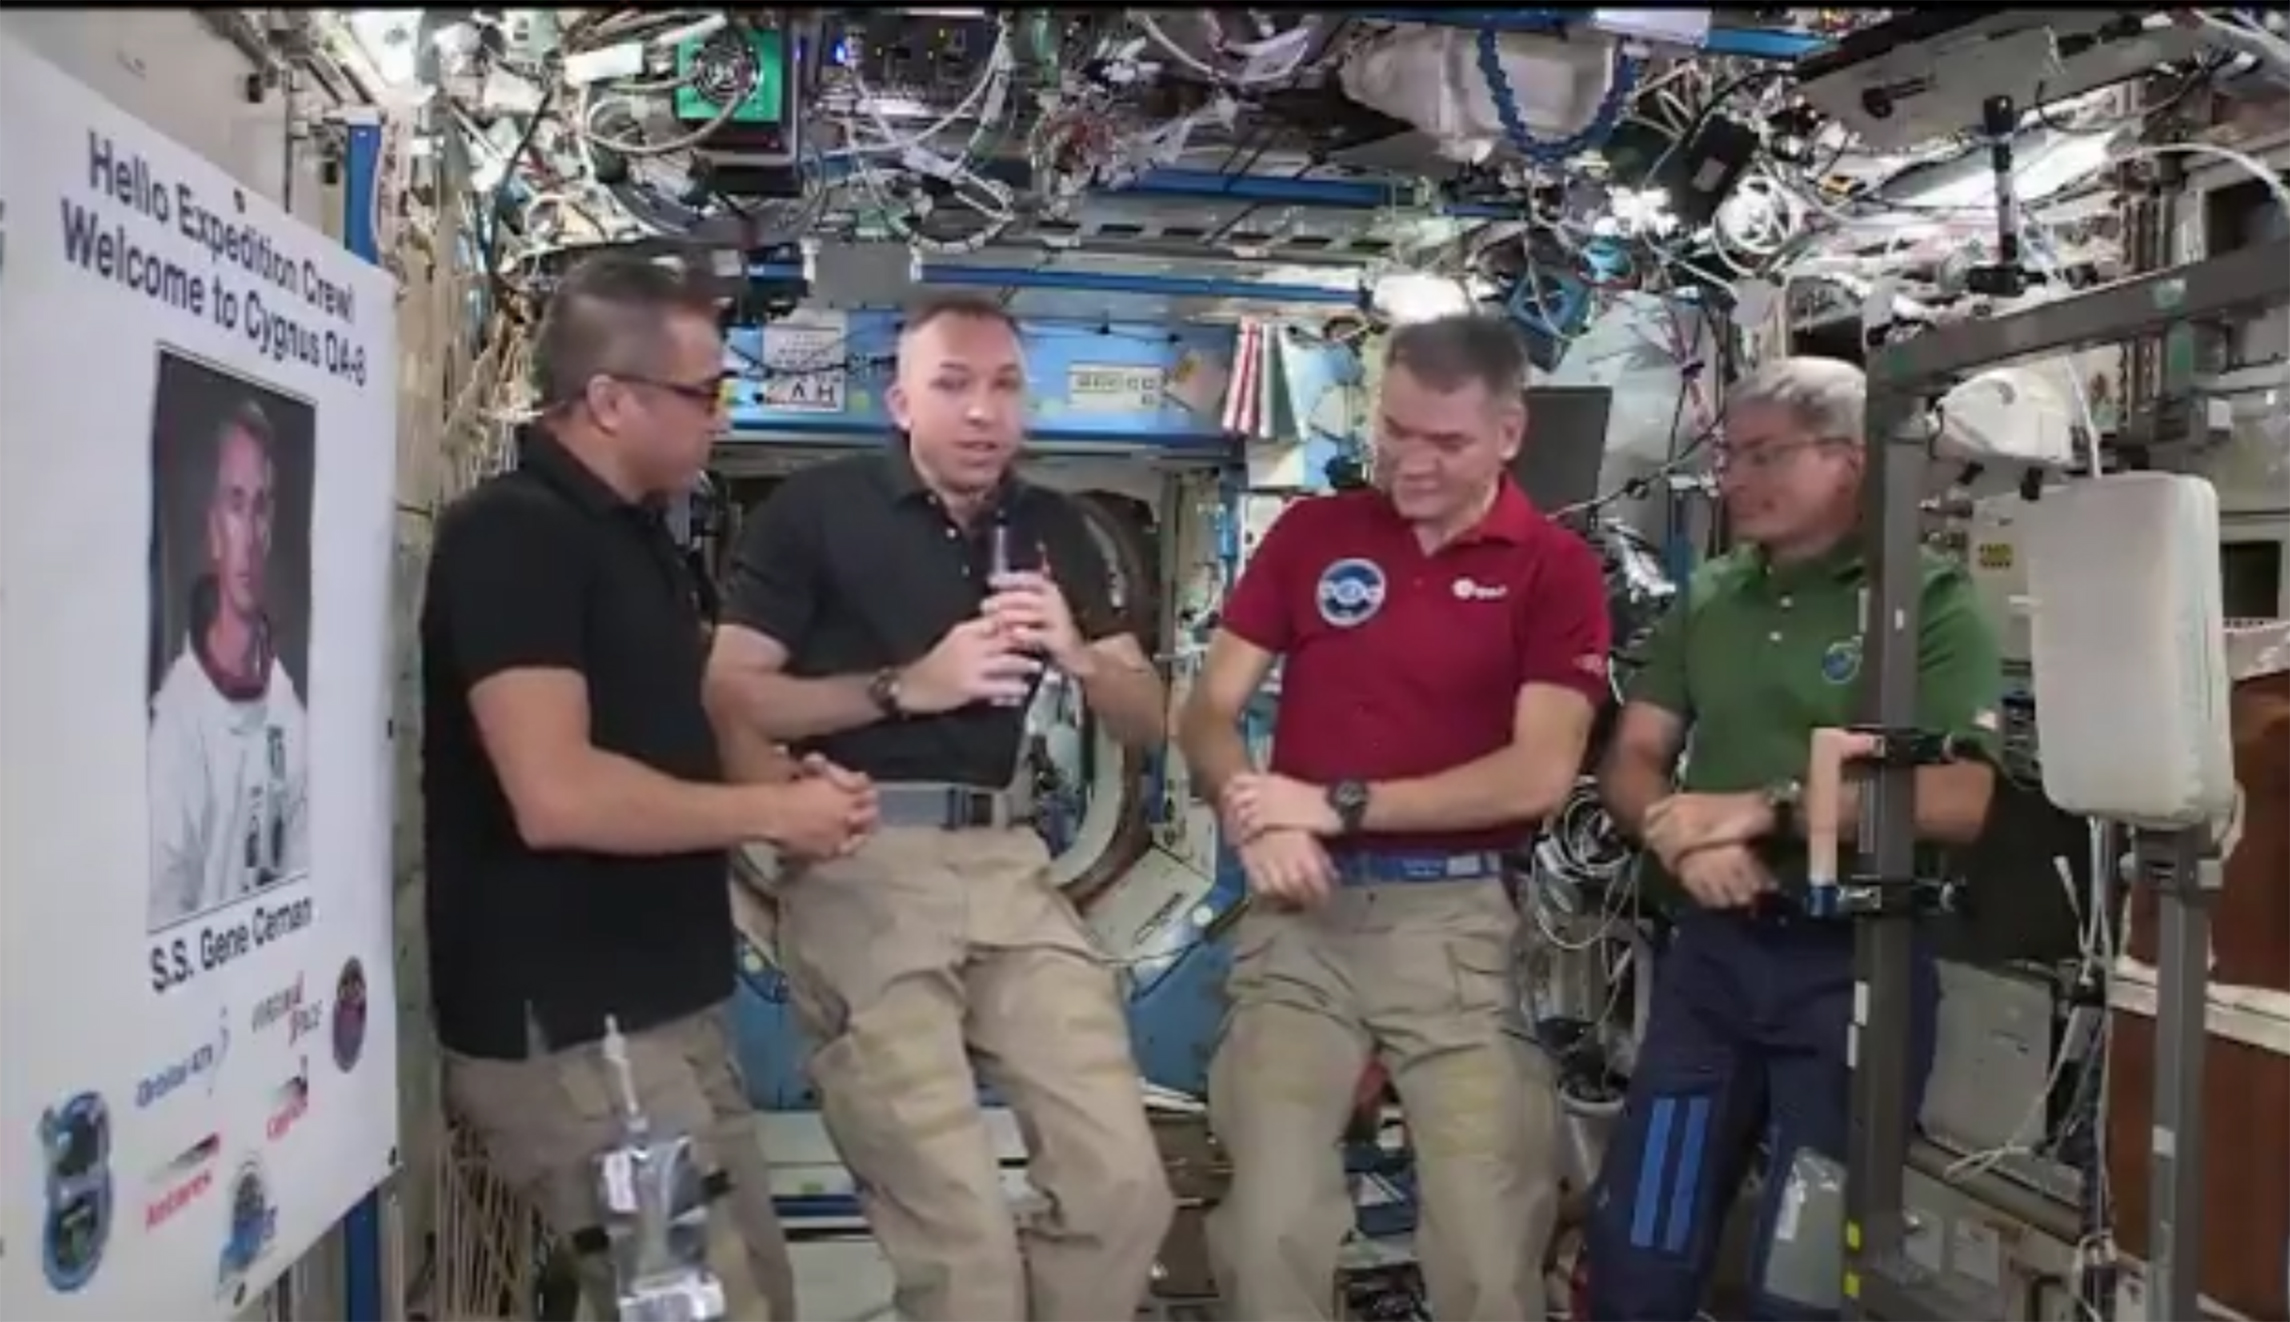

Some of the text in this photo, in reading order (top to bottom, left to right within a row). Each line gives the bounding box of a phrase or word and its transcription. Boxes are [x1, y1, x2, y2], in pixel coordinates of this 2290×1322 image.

[61, 197, 204, 316] Welcome
[213, 275, 238, 329] to
[244, 290, 320, 367] Cygnus
[88, 129, 170, 224] Hello
[176, 182, 299, 293] Expedition
[150, 936, 195, 994] S.S.
[201, 922, 249, 971] Gene
